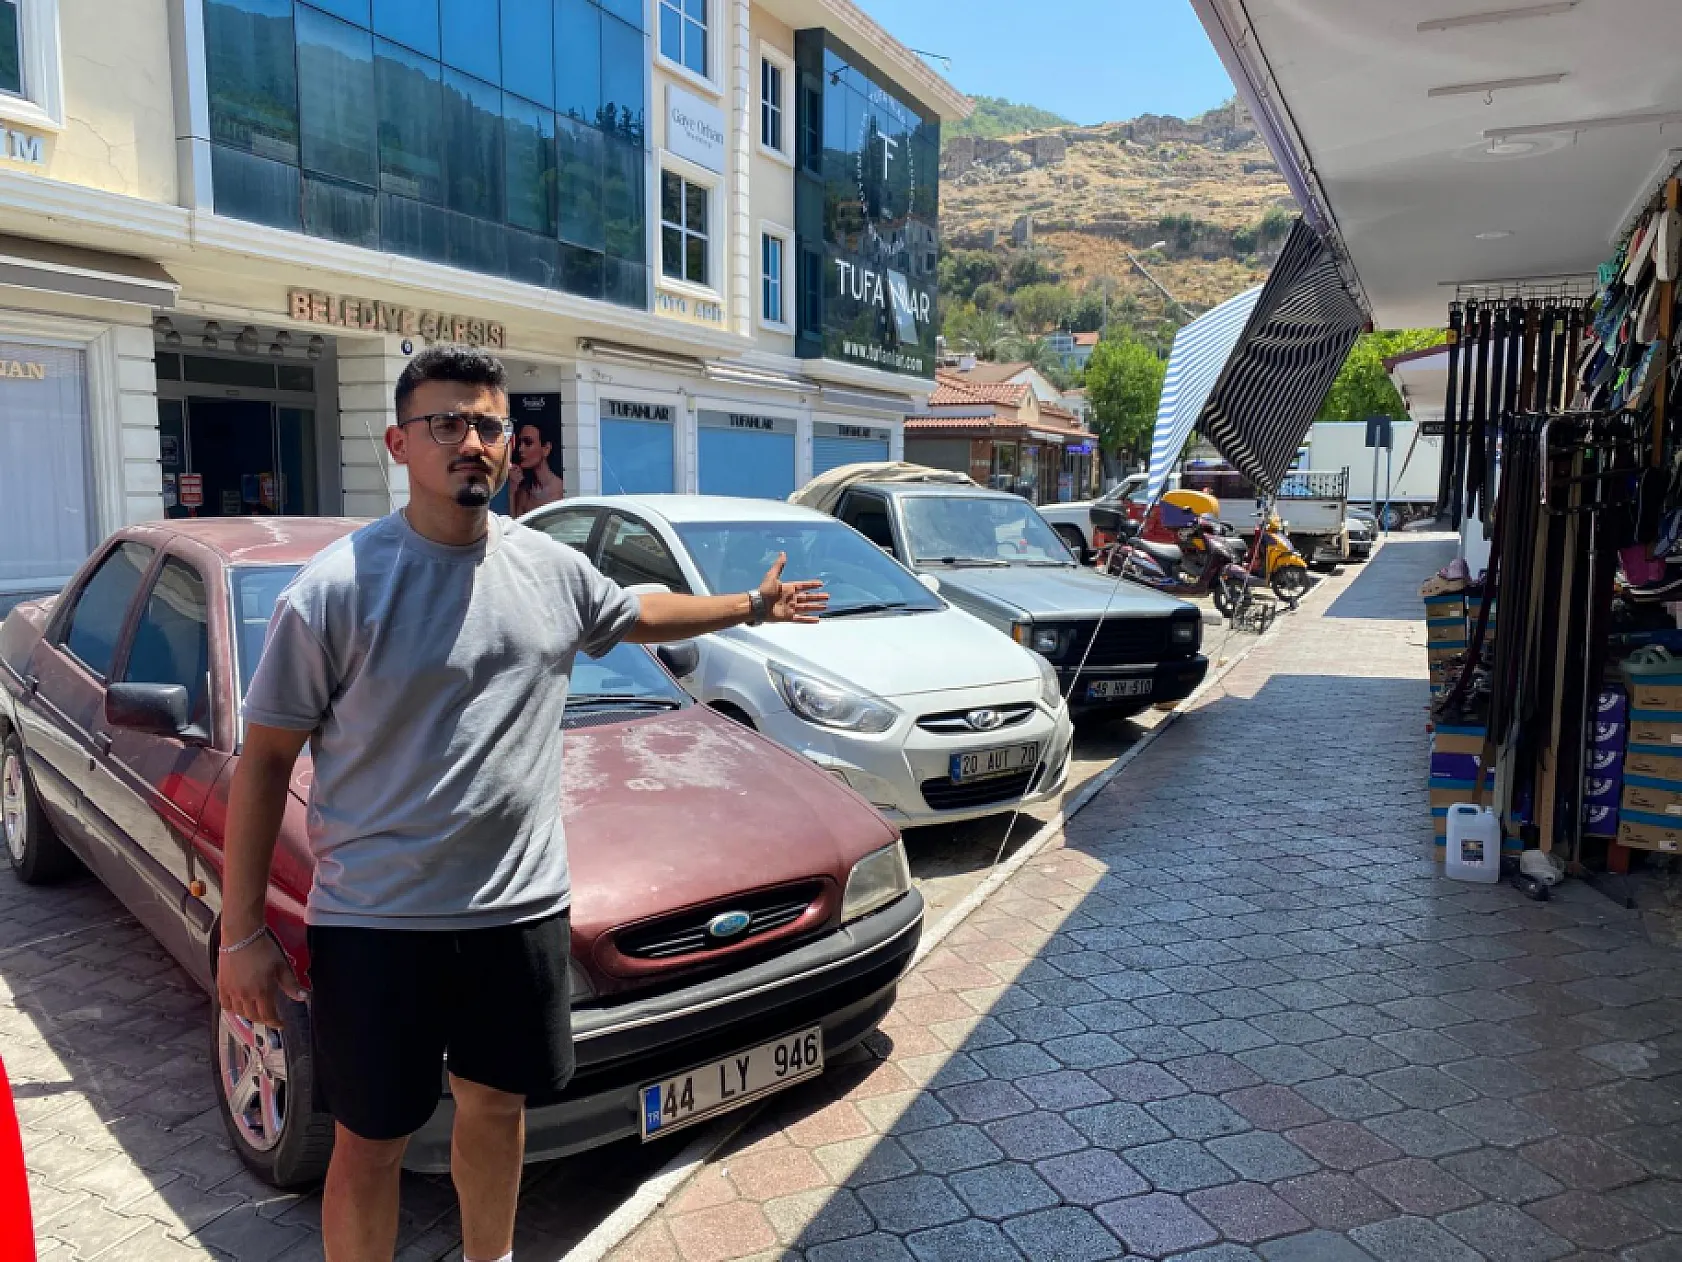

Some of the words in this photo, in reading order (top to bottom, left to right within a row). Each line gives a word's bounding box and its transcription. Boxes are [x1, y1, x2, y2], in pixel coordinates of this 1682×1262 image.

[962, 755, 978, 775] 20
[1021, 746, 1035, 764] 70
[647, 1110, 659, 1124] TR
[663, 1076, 694, 1118] 44
[719, 1056, 750, 1098] LY
[774, 1033, 818, 1077] 946
